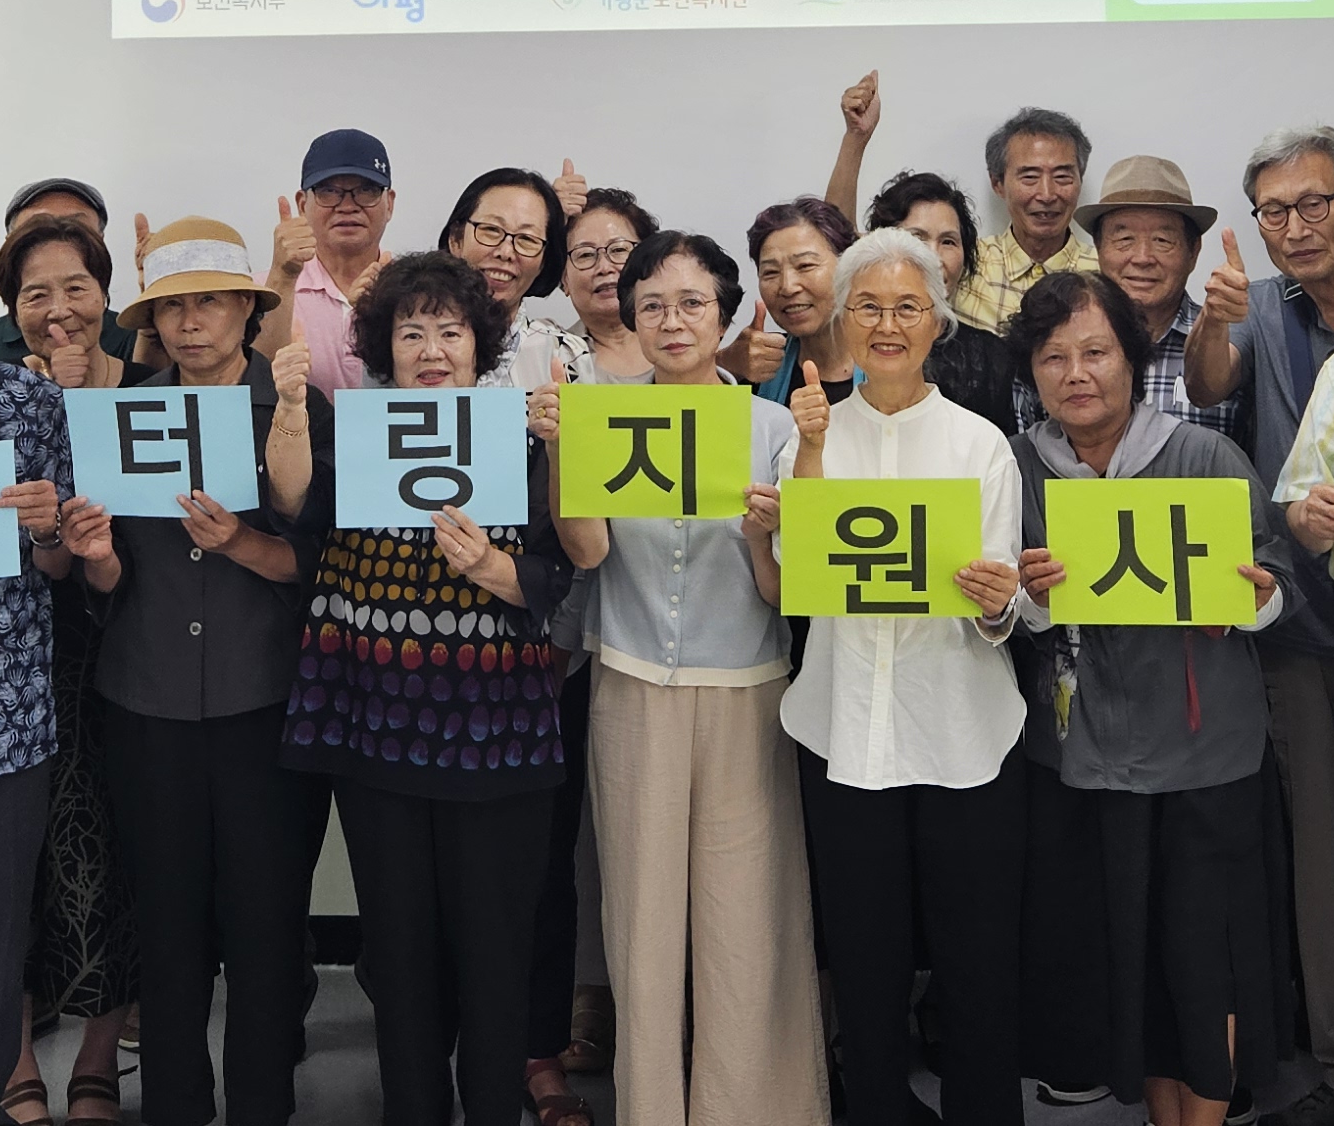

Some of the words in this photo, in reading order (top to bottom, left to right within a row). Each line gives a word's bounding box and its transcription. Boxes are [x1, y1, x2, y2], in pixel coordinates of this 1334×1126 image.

[116, 394, 205, 500] 터
[388, 396, 473, 512] 링
[604, 409, 697, 515] 지
[828, 504, 930, 614] 원
[1089, 504, 1209, 622] 사
